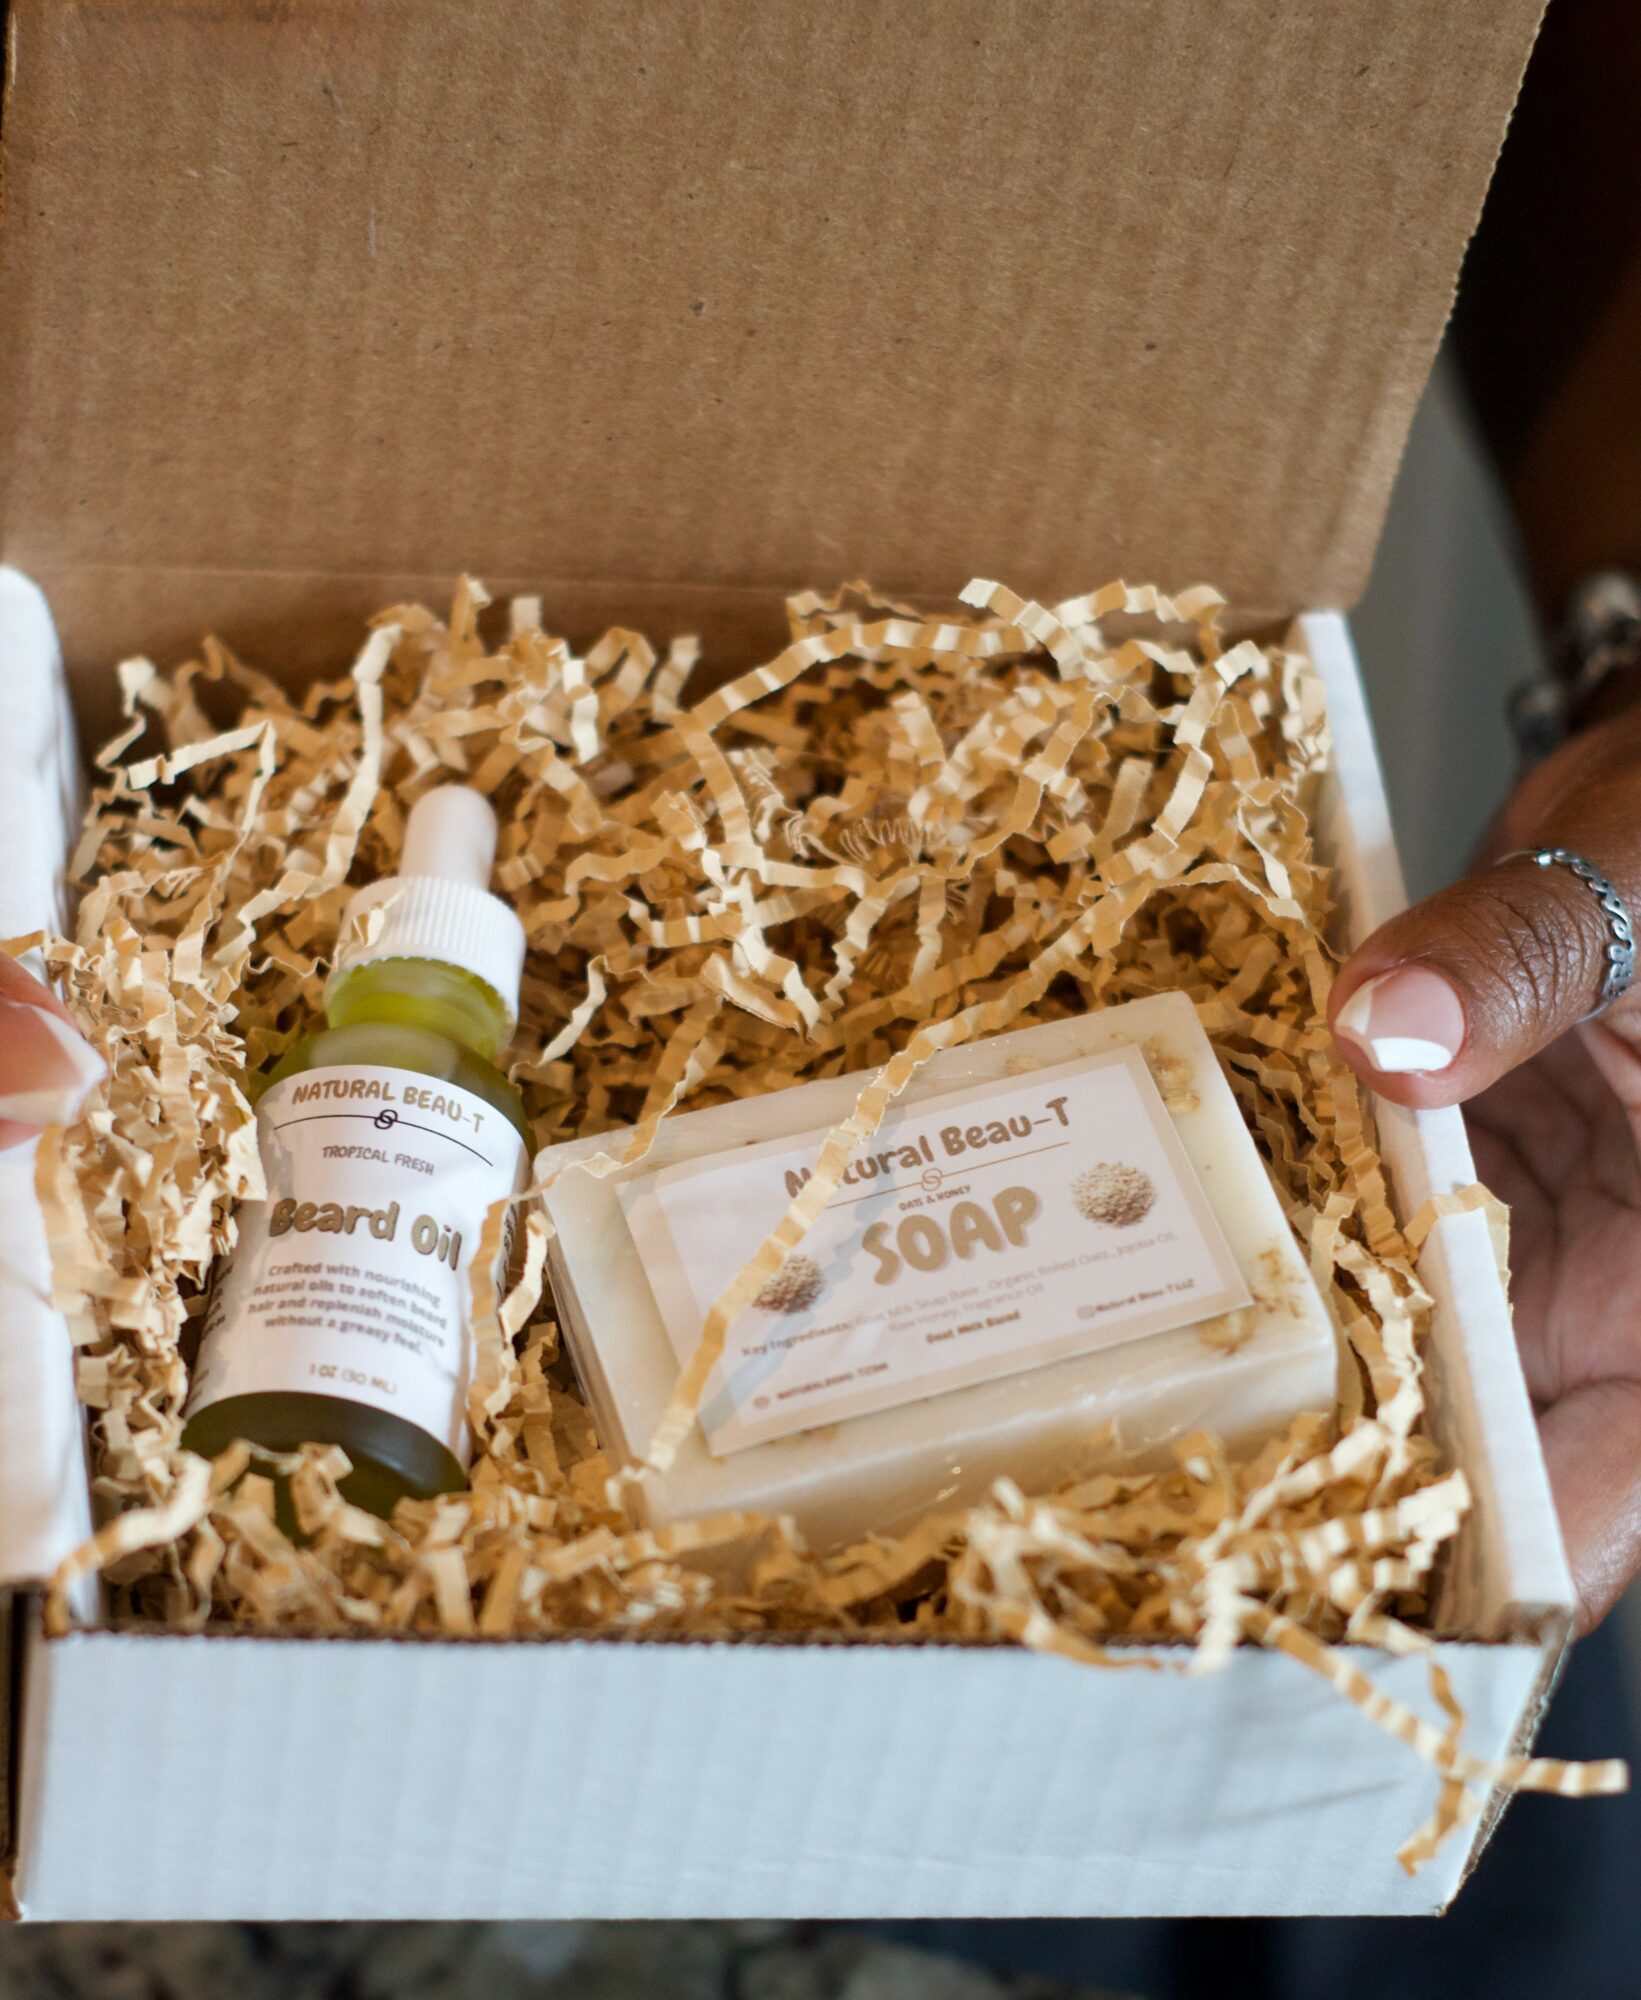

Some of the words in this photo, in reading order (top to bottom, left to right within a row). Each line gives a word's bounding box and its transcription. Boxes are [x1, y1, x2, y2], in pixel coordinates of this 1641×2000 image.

[292, 1079, 395, 1105] NATURAL
[403, 1086, 485, 1133] BEAU-T
[322, 1145, 389, 1162] TROPICAL
[394, 1153, 434, 1175] FRESH
[784, 1135, 935, 1199] Ntural
[938, 1096, 1071, 1157] Beau-T
[936, 1184, 970, 1201] HONEY
[269, 1198, 400, 1242] Beard
[411, 1214, 462, 1271] Oil
[861, 1185, 1043, 1286] SOAP
[254, 1280, 305, 1296] natural
[308, 1280, 334, 1292] oils
[340, 1283, 355, 1295] to
[359, 1287, 406, 1308] soften
[411, 1301, 446, 1329] beard
[268, 1262, 322, 1277] Crafted
[326, 1264, 360, 1277] with
[364, 1270, 441, 1309] nourishing
[248, 1301, 273, 1314] hair
[278, 1298, 306, 1309] and
[310, 1300, 382, 1318] replenish
[386, 1313, 445, 1348] moisture
[265, 1315, 322, 1328] without
[328, 1319, 336, 1328] a
[339, 1320, 390, 1343] greasy
[319, 1364, 337, 1379] OZ
